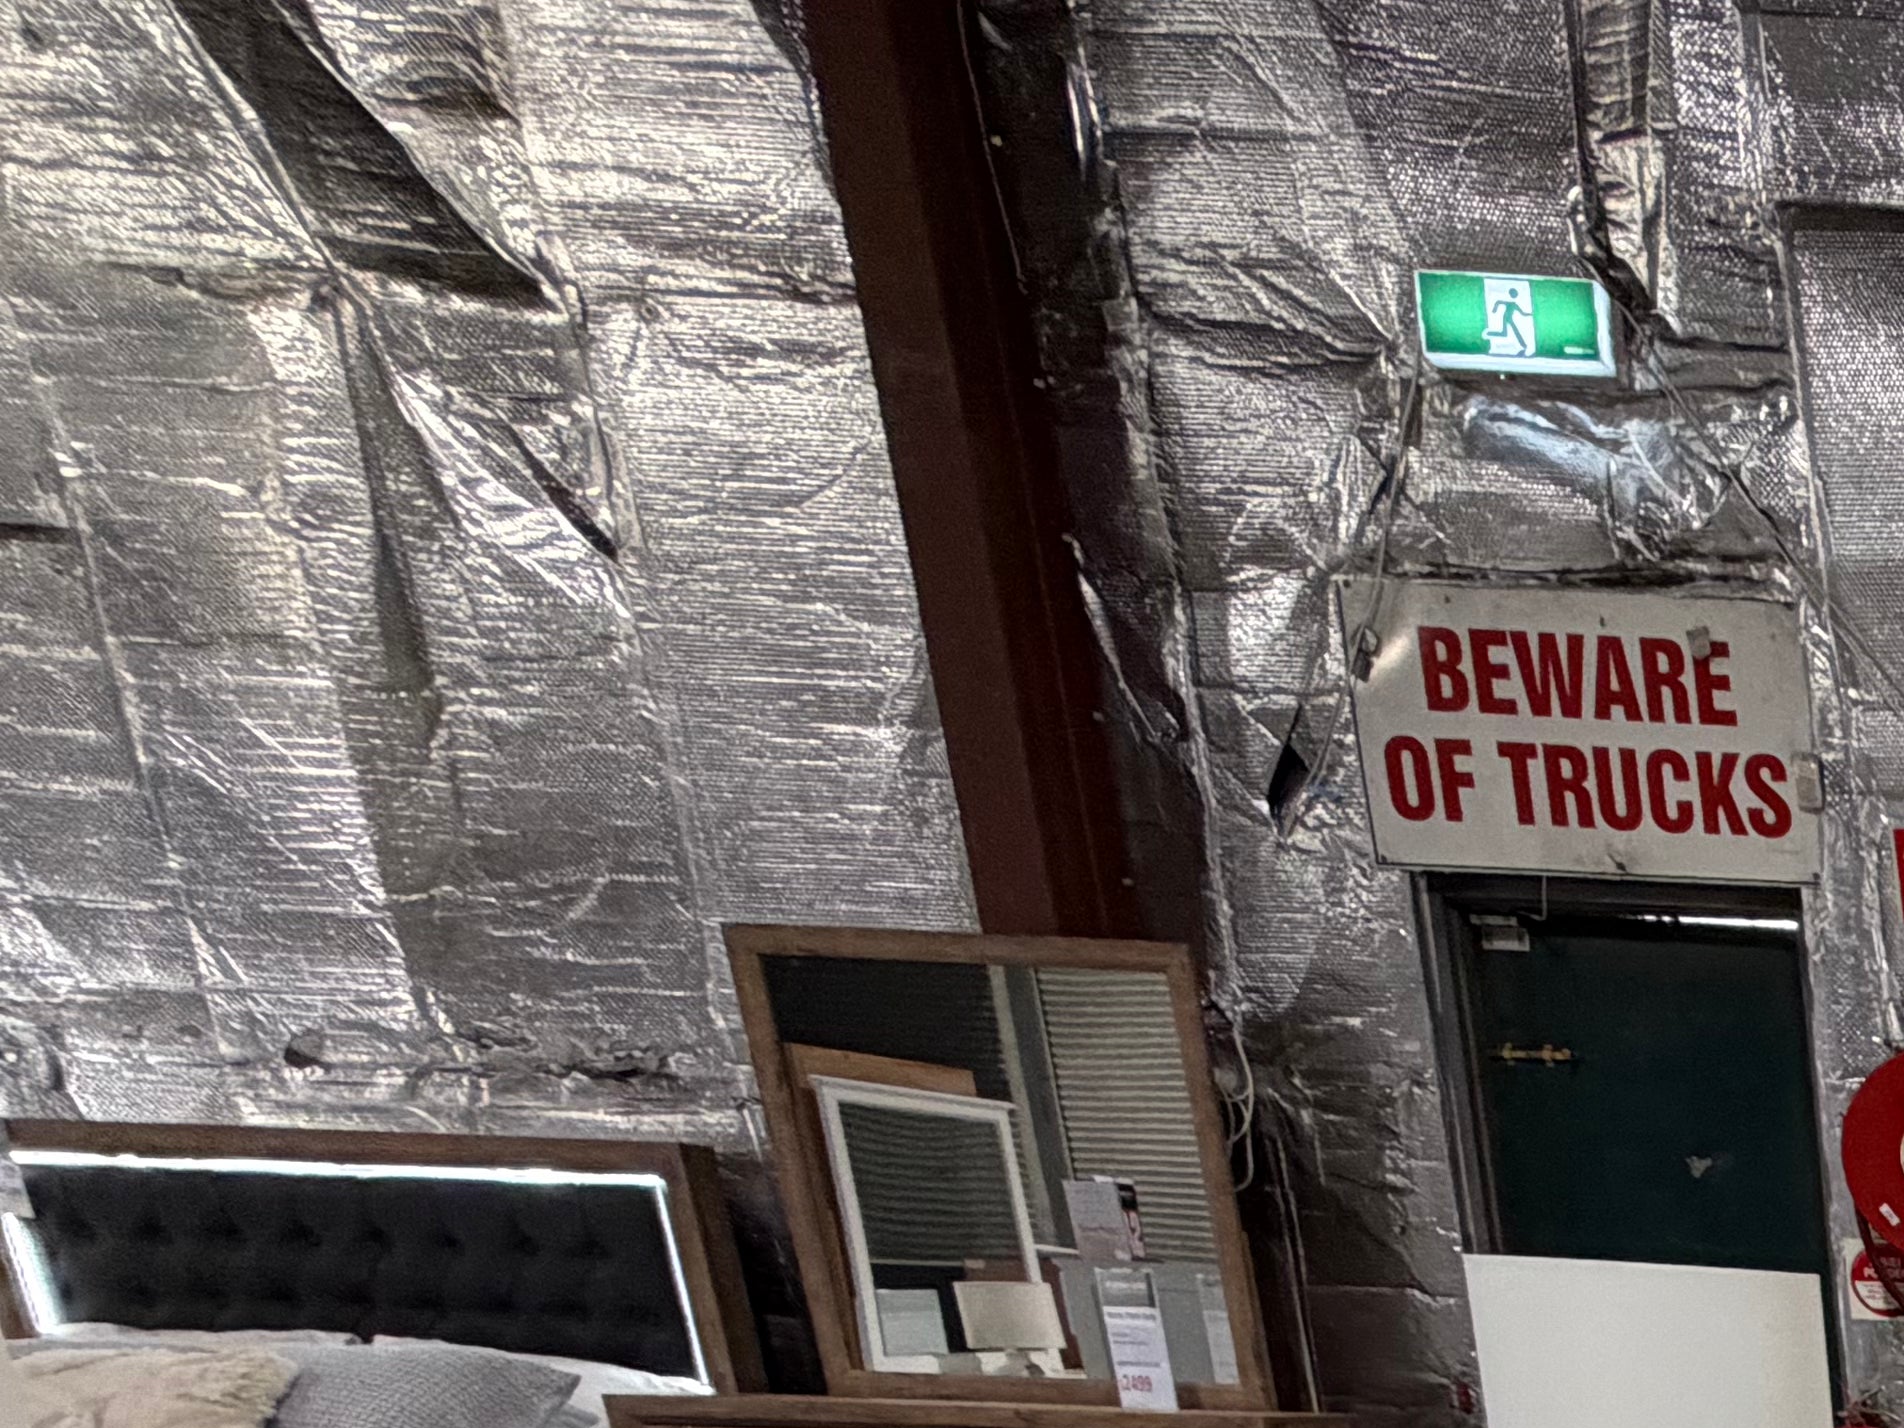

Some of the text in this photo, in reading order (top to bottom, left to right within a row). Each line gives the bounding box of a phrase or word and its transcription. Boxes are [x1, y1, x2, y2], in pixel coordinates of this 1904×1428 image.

[1417, 626, 1738, 727] BEWARE
[1384, 735, 1792, 839] OF TRUCKS
